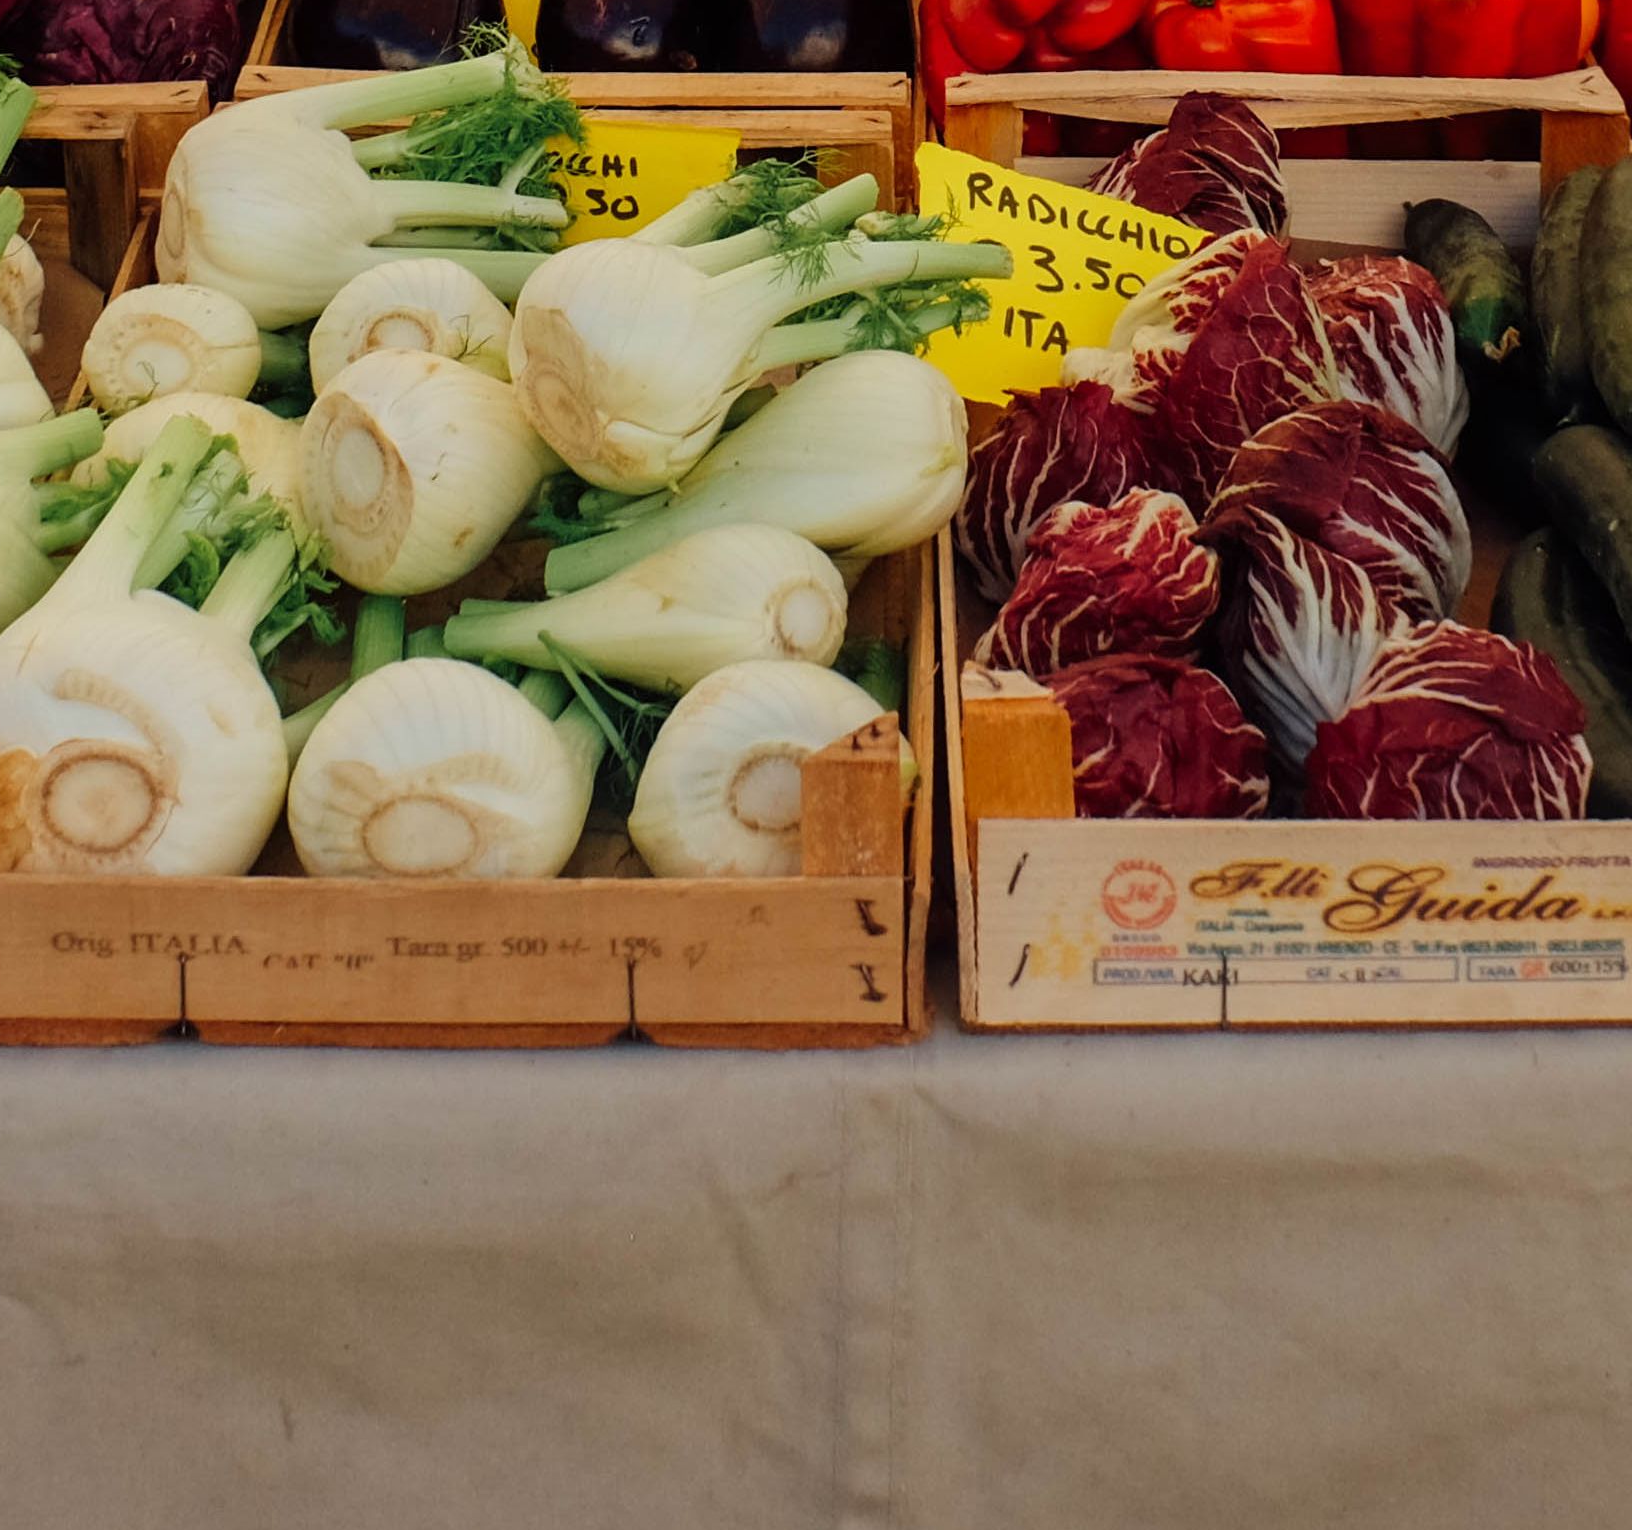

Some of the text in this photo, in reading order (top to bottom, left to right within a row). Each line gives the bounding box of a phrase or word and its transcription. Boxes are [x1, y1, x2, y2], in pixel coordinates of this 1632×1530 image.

[966, 172, 1191, 260] RADICCHIO
[1028, 245, 1146, 300] 3.50
[1003, 306, 1069, 356] ITA
[1322, 864, 1585, 934] Guida
[130, 932, 249, 957] ITALIA
[387, 935, 448, 959] Tara
[501, 935, 548, 958] 500
[608, 935, 662, 959] 15%
[1182, 968, 1239, 986] KAKI
